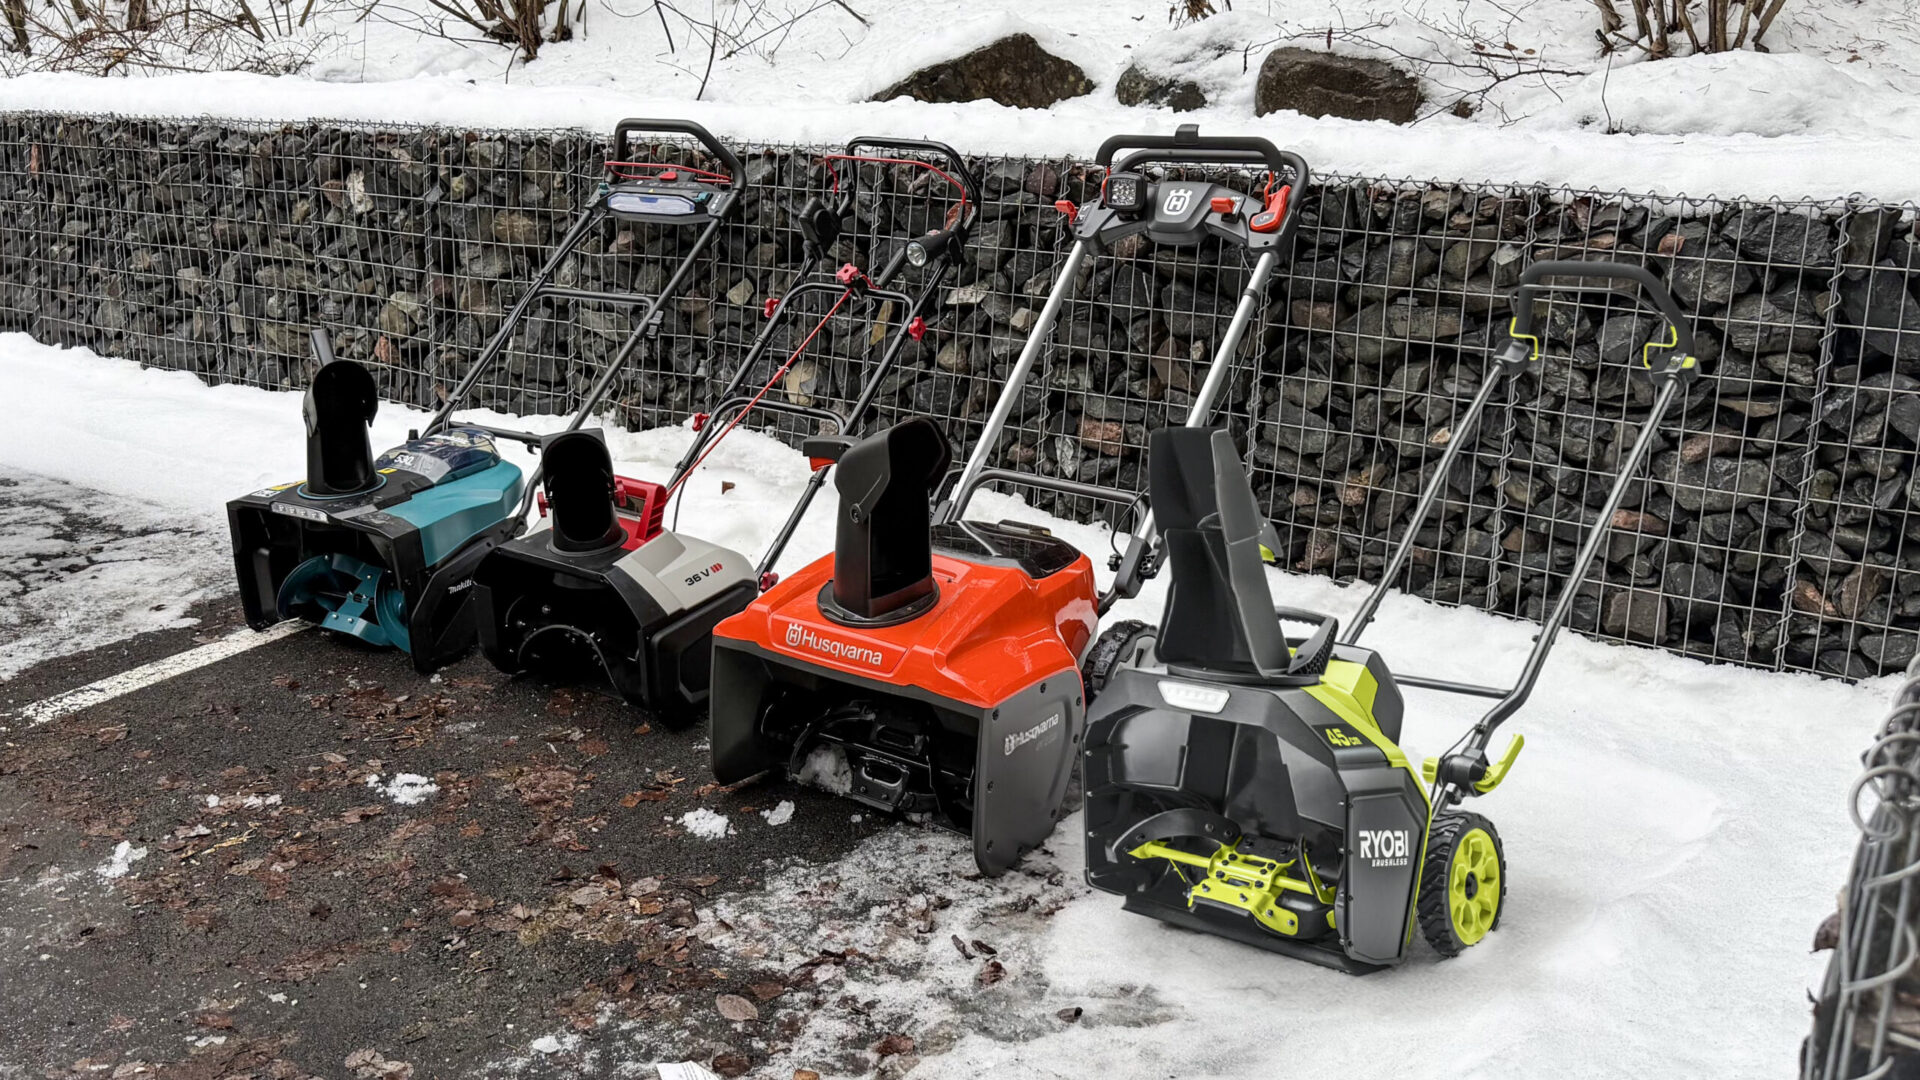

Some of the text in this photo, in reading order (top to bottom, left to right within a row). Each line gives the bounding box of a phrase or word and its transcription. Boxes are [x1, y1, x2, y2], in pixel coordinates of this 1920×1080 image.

[684, 568, 710, 586] 36 V
[802, 629, 883, 665] Husqvarna
[1359, 829, 1409, 858] RYOBI
[1371, 858, 1408, 868] BRUSHLESS
